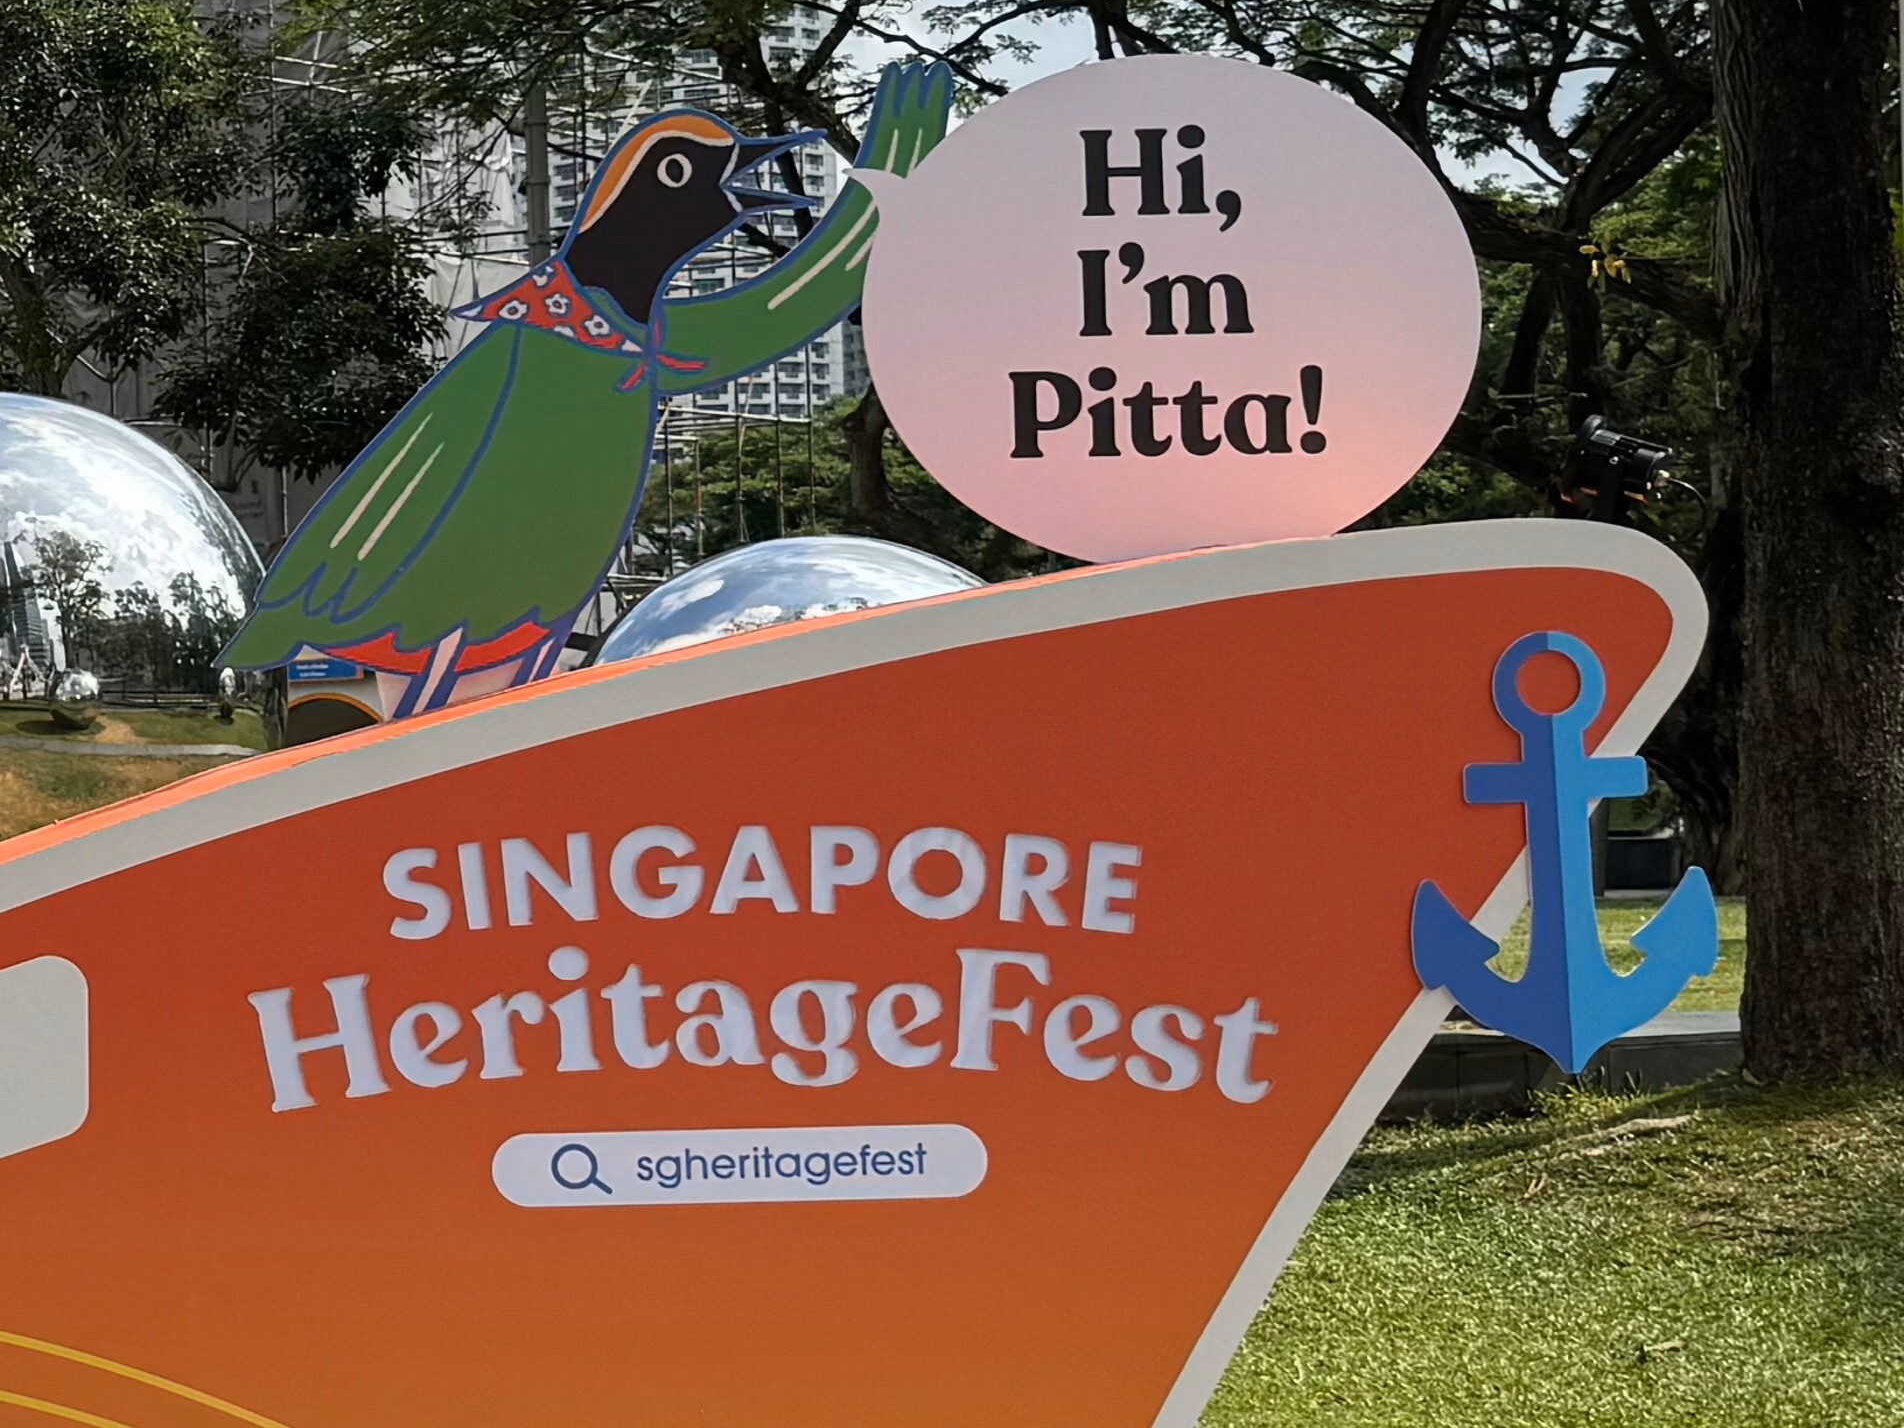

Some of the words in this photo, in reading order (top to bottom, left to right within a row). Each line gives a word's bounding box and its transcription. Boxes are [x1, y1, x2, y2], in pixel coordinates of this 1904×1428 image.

[1079, 124, 1242, 232] Hi,
[1077, 242, 1254, 337] I'm
[1008, 364, 1327, 459] Pitta!
[382, 823, 1143, 941] SINGAPORE
[247, 945, 1278, 1114] HeritageFest
[635, 1141, 928, 1189] sgheritagefest
